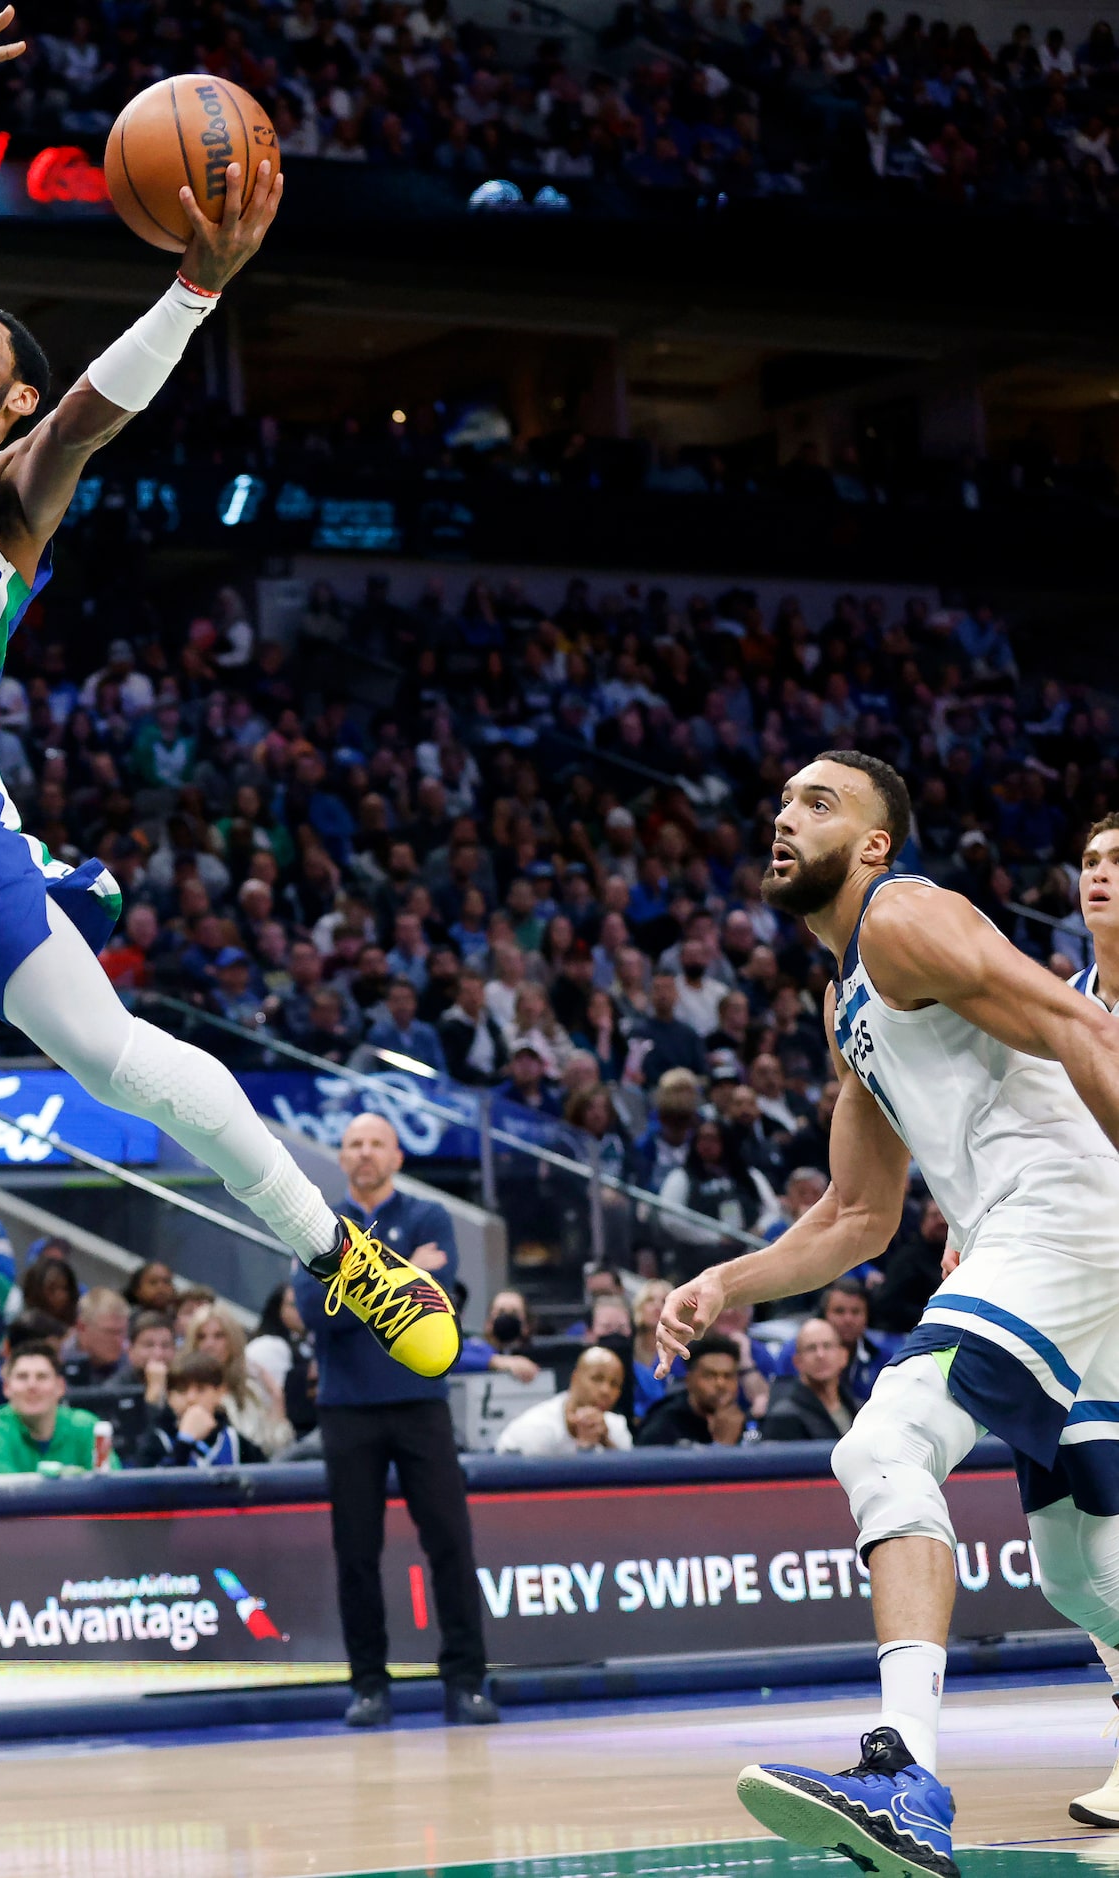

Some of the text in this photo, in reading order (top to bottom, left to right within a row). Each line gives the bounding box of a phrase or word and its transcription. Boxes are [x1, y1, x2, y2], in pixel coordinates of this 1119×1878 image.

[195, 85, 233, 200] Wilson
[476, 1561, 606, 1619] VERY
[613, 1553, 763, 1613] SWIPE
